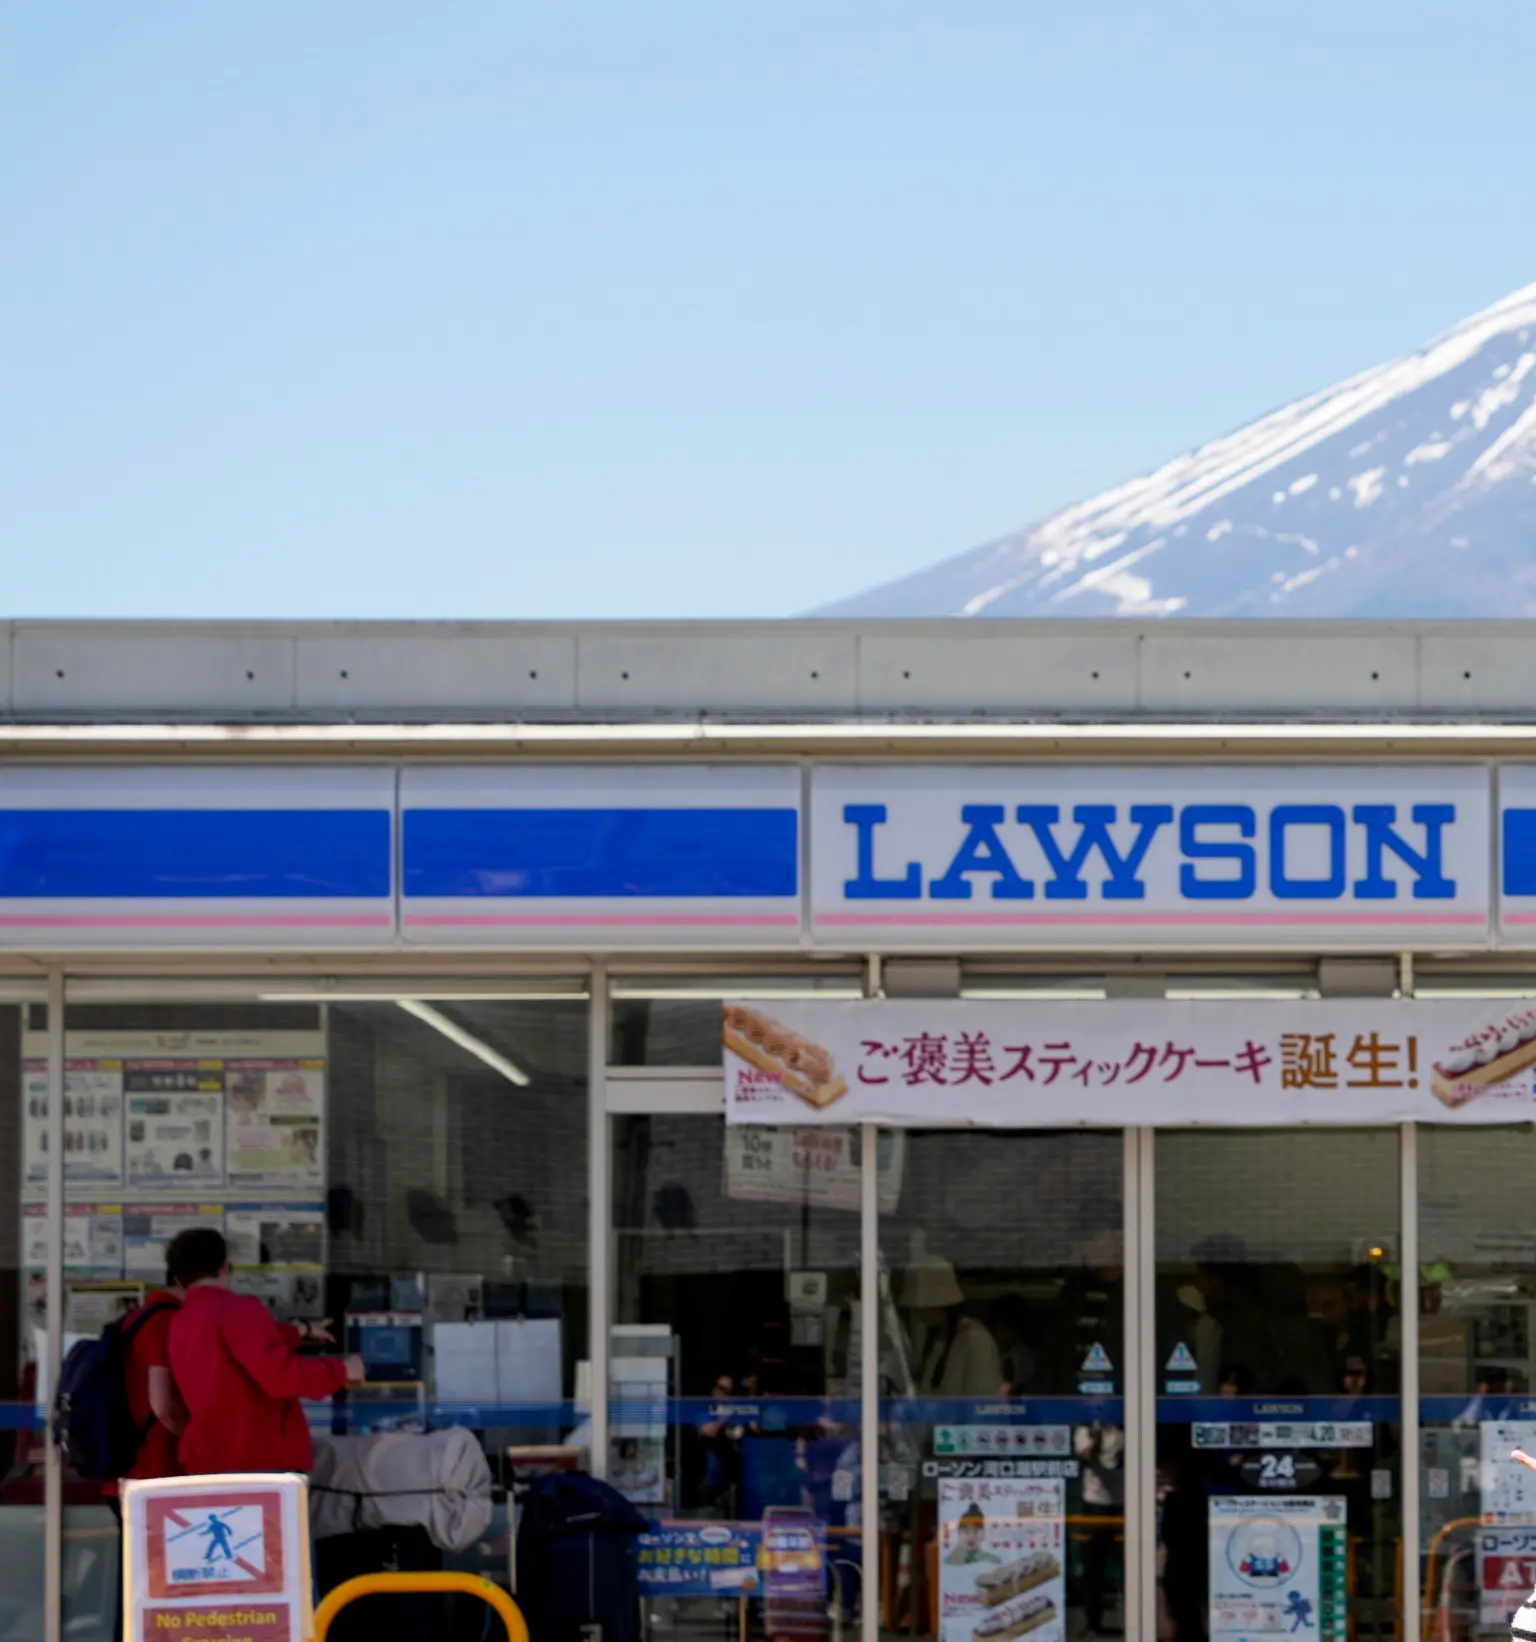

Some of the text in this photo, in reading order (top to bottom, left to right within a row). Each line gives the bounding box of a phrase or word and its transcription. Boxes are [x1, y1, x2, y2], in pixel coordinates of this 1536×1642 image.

[843, 804, 1456, 900] LAWSON
[737, 1069, 783, 1084] New
[1260, 1454, 1296, 1478] 24
[156, 1610, 276, 1629] No Pedestrian
